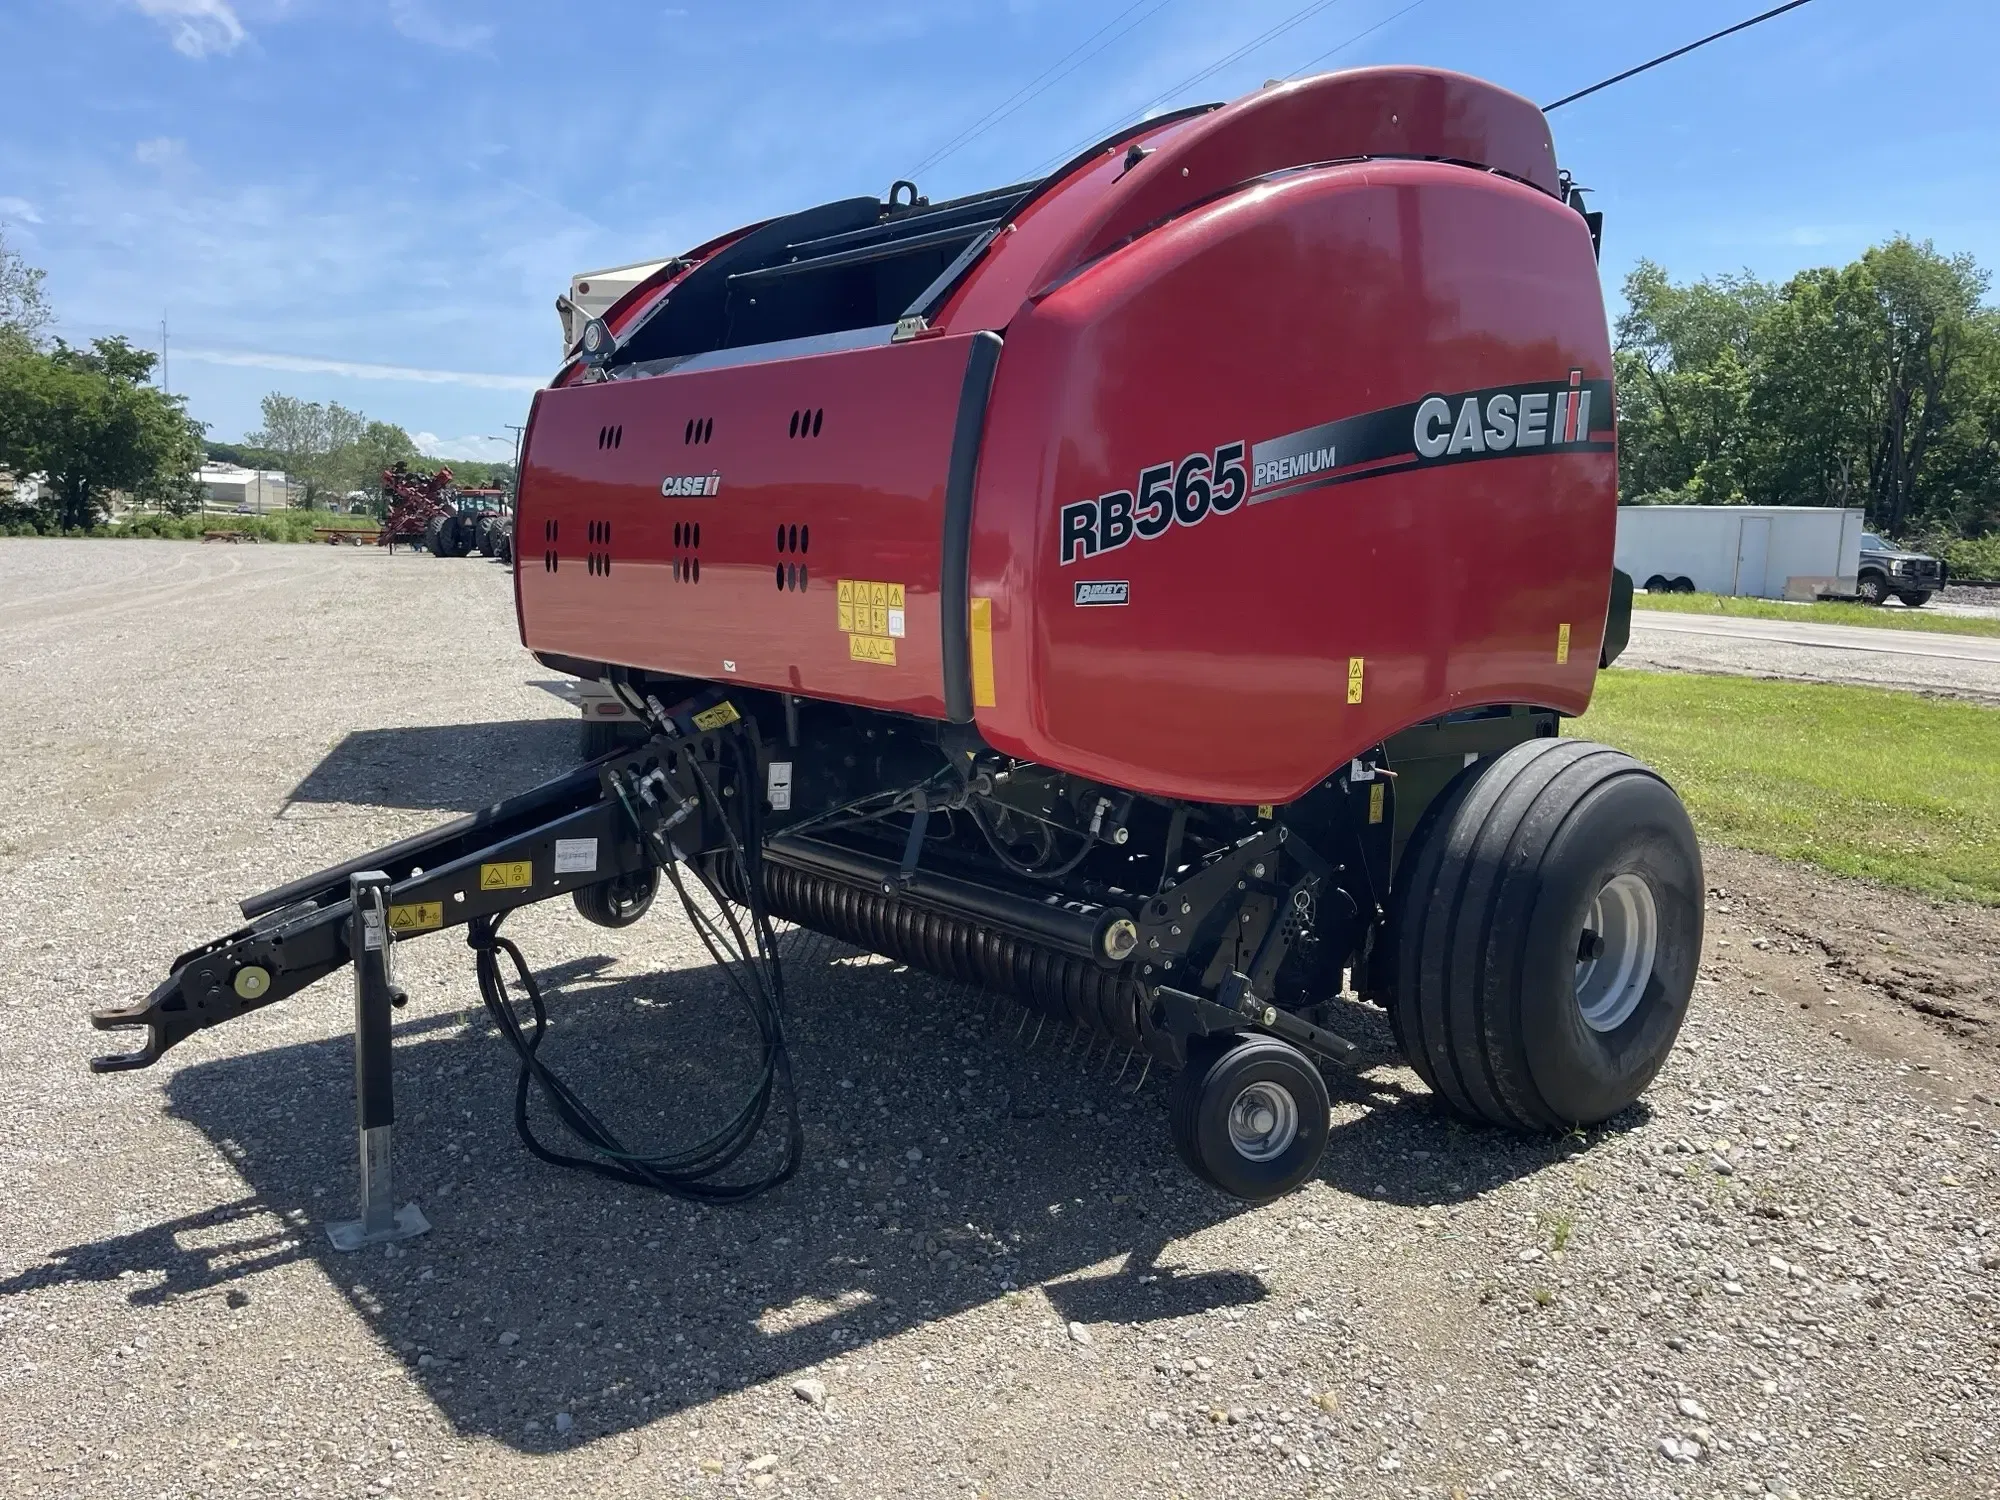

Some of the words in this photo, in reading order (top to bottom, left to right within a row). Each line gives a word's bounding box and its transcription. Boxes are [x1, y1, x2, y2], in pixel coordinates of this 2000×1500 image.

[1413, 392, 1549, 458] CASE
[661, 475, 705, 497] CASE
[1254, 447, 1336, 487] PREMIUM
[1060, 440, 1247, 566] RB565
[1076, 583, 1128, 604] BIRKEY'S
